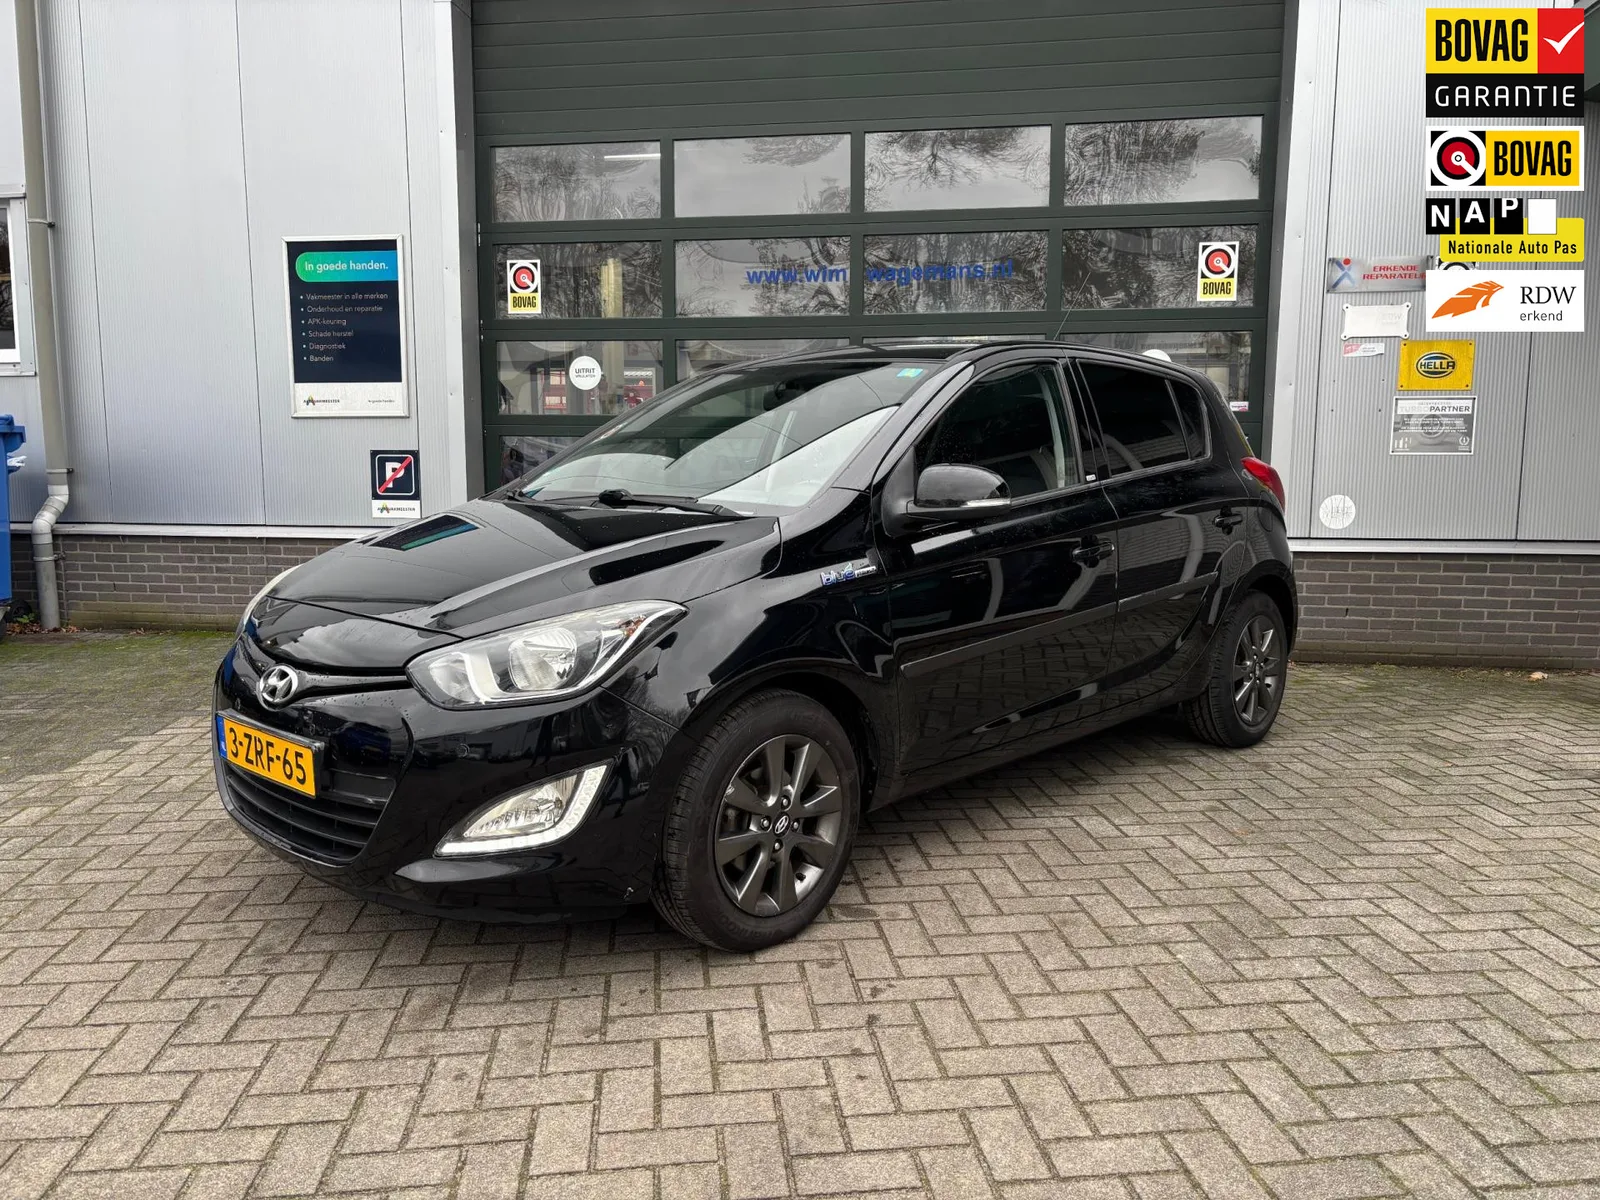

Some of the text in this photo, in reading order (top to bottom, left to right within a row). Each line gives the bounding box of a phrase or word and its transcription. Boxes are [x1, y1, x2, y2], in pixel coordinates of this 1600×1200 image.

[304, 260, 389, 273] In goede handen.
[1202, 281, 1232, 295] BOVAG
[512, 295, 537, 308] BOVAG
[1420, 361, 1456, 370] HELLA
[229, 727, 307, 786] 3-ZRF-65
